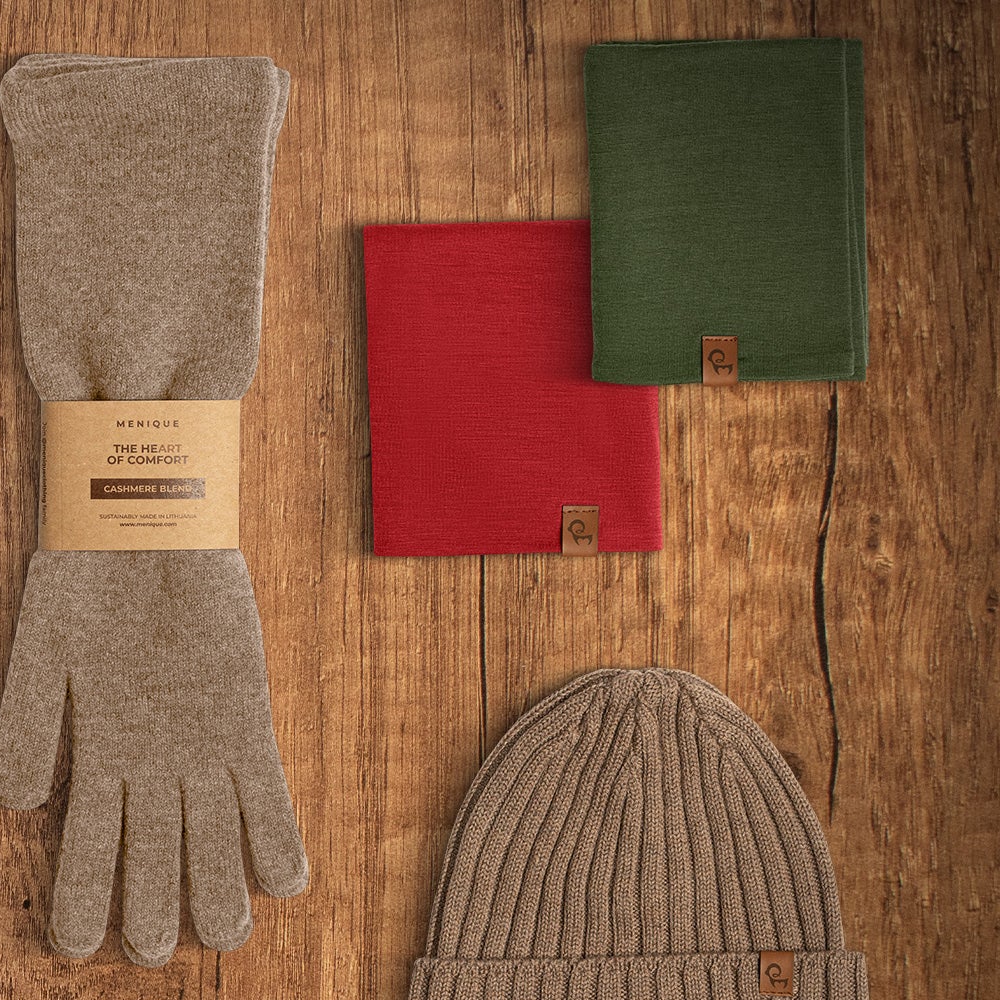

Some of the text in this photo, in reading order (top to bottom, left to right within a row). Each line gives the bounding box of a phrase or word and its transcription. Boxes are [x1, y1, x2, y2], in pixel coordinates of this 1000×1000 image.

[116, 419, 180, 428] MENIQUE
[113, 444, 182, 454] THE HEART
[107, 455, 189, 465] OF COMFORT
[103, 484, 192, 493] CASHMERE BLEND
